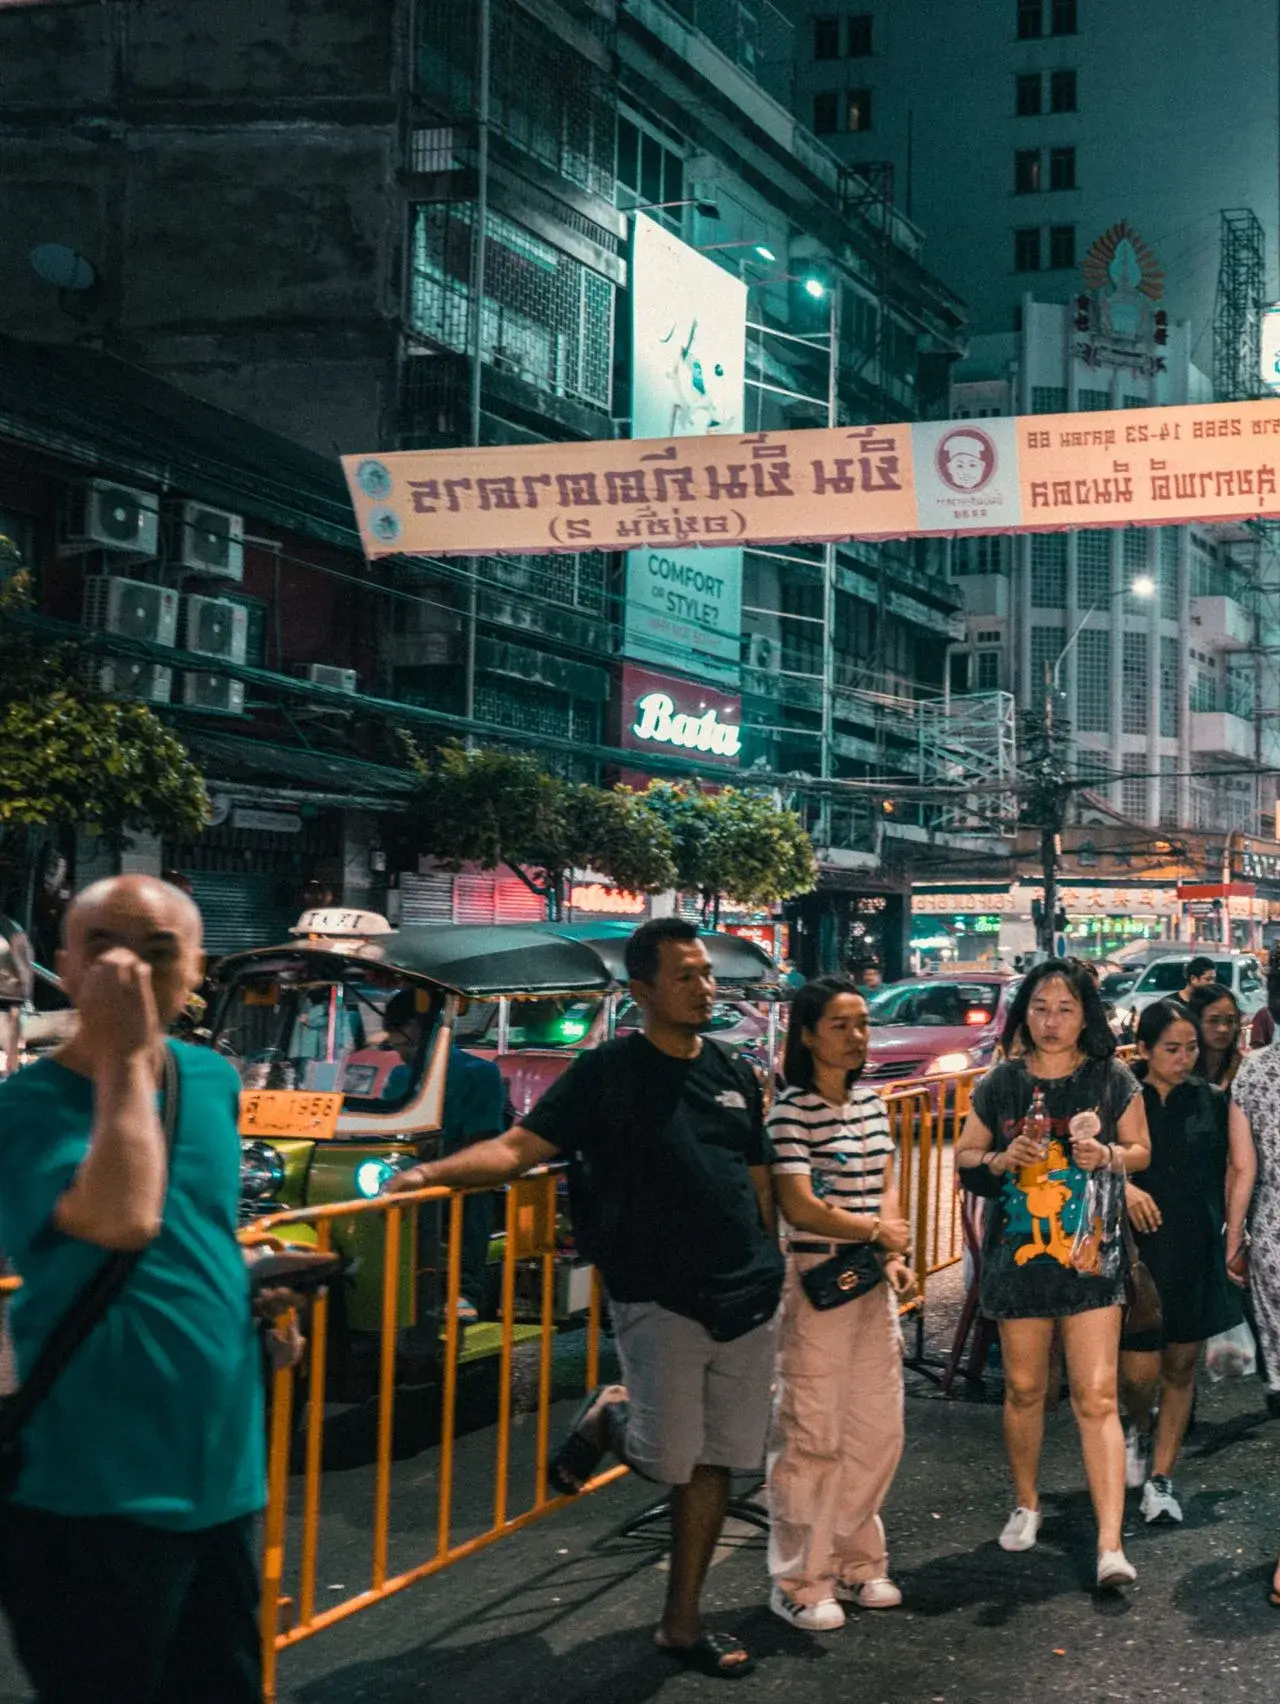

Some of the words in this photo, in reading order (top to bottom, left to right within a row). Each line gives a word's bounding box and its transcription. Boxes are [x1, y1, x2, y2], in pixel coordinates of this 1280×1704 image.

[648, 554, 724, 599] COMFORT
[666, 591, 719, 627] STYLE?
[633, 692, 741, 757] Bata
